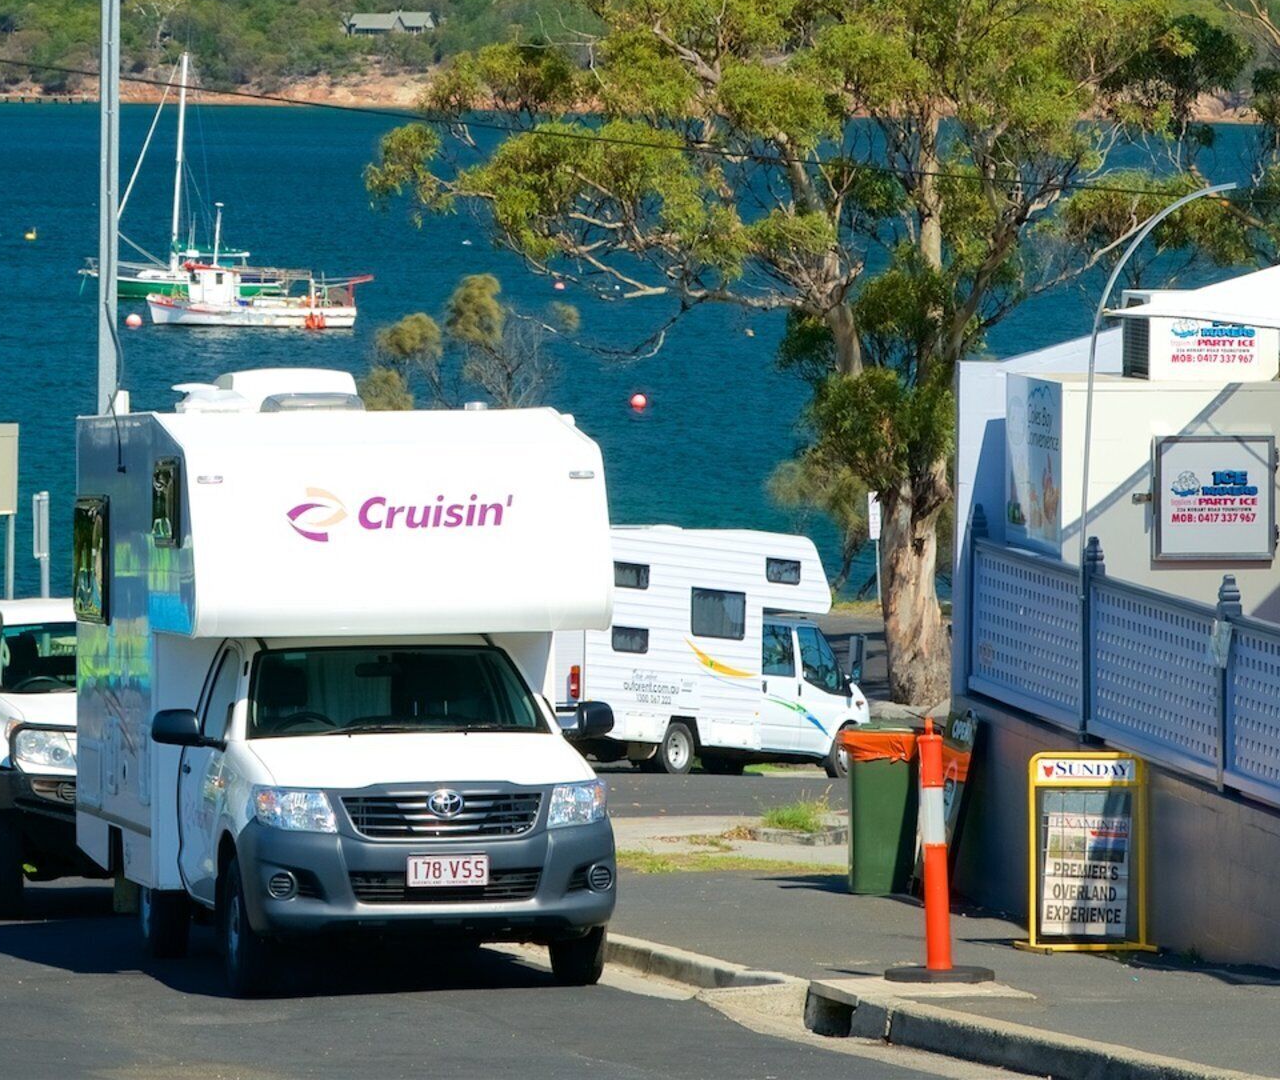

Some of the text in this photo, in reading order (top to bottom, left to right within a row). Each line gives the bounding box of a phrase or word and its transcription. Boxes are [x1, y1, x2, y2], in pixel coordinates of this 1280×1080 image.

[1198, 339, 1234, 347] PARTY
[1238, 339, 1255, 347] ICE
[1171, 354, 1254, 363] MOB: 0417 337 967
[1211, 469, 1248, 486] ICE
[1198, 498, 1236, 506] PARTY
[1239, 498, 1258, 506] ICE
[358, 494, 513, 530] Cruisin'
[1171, 513, 1256, 523] MOB: 0417 337 967
[1055, 761, 1130, 776] SUNDAY
[1053, 862, 1119, 881] PREMIER'S
[1052, 883, 1117, 902] OVERLAND
[1046, 904, 1122, 924] EXPERIENCE
